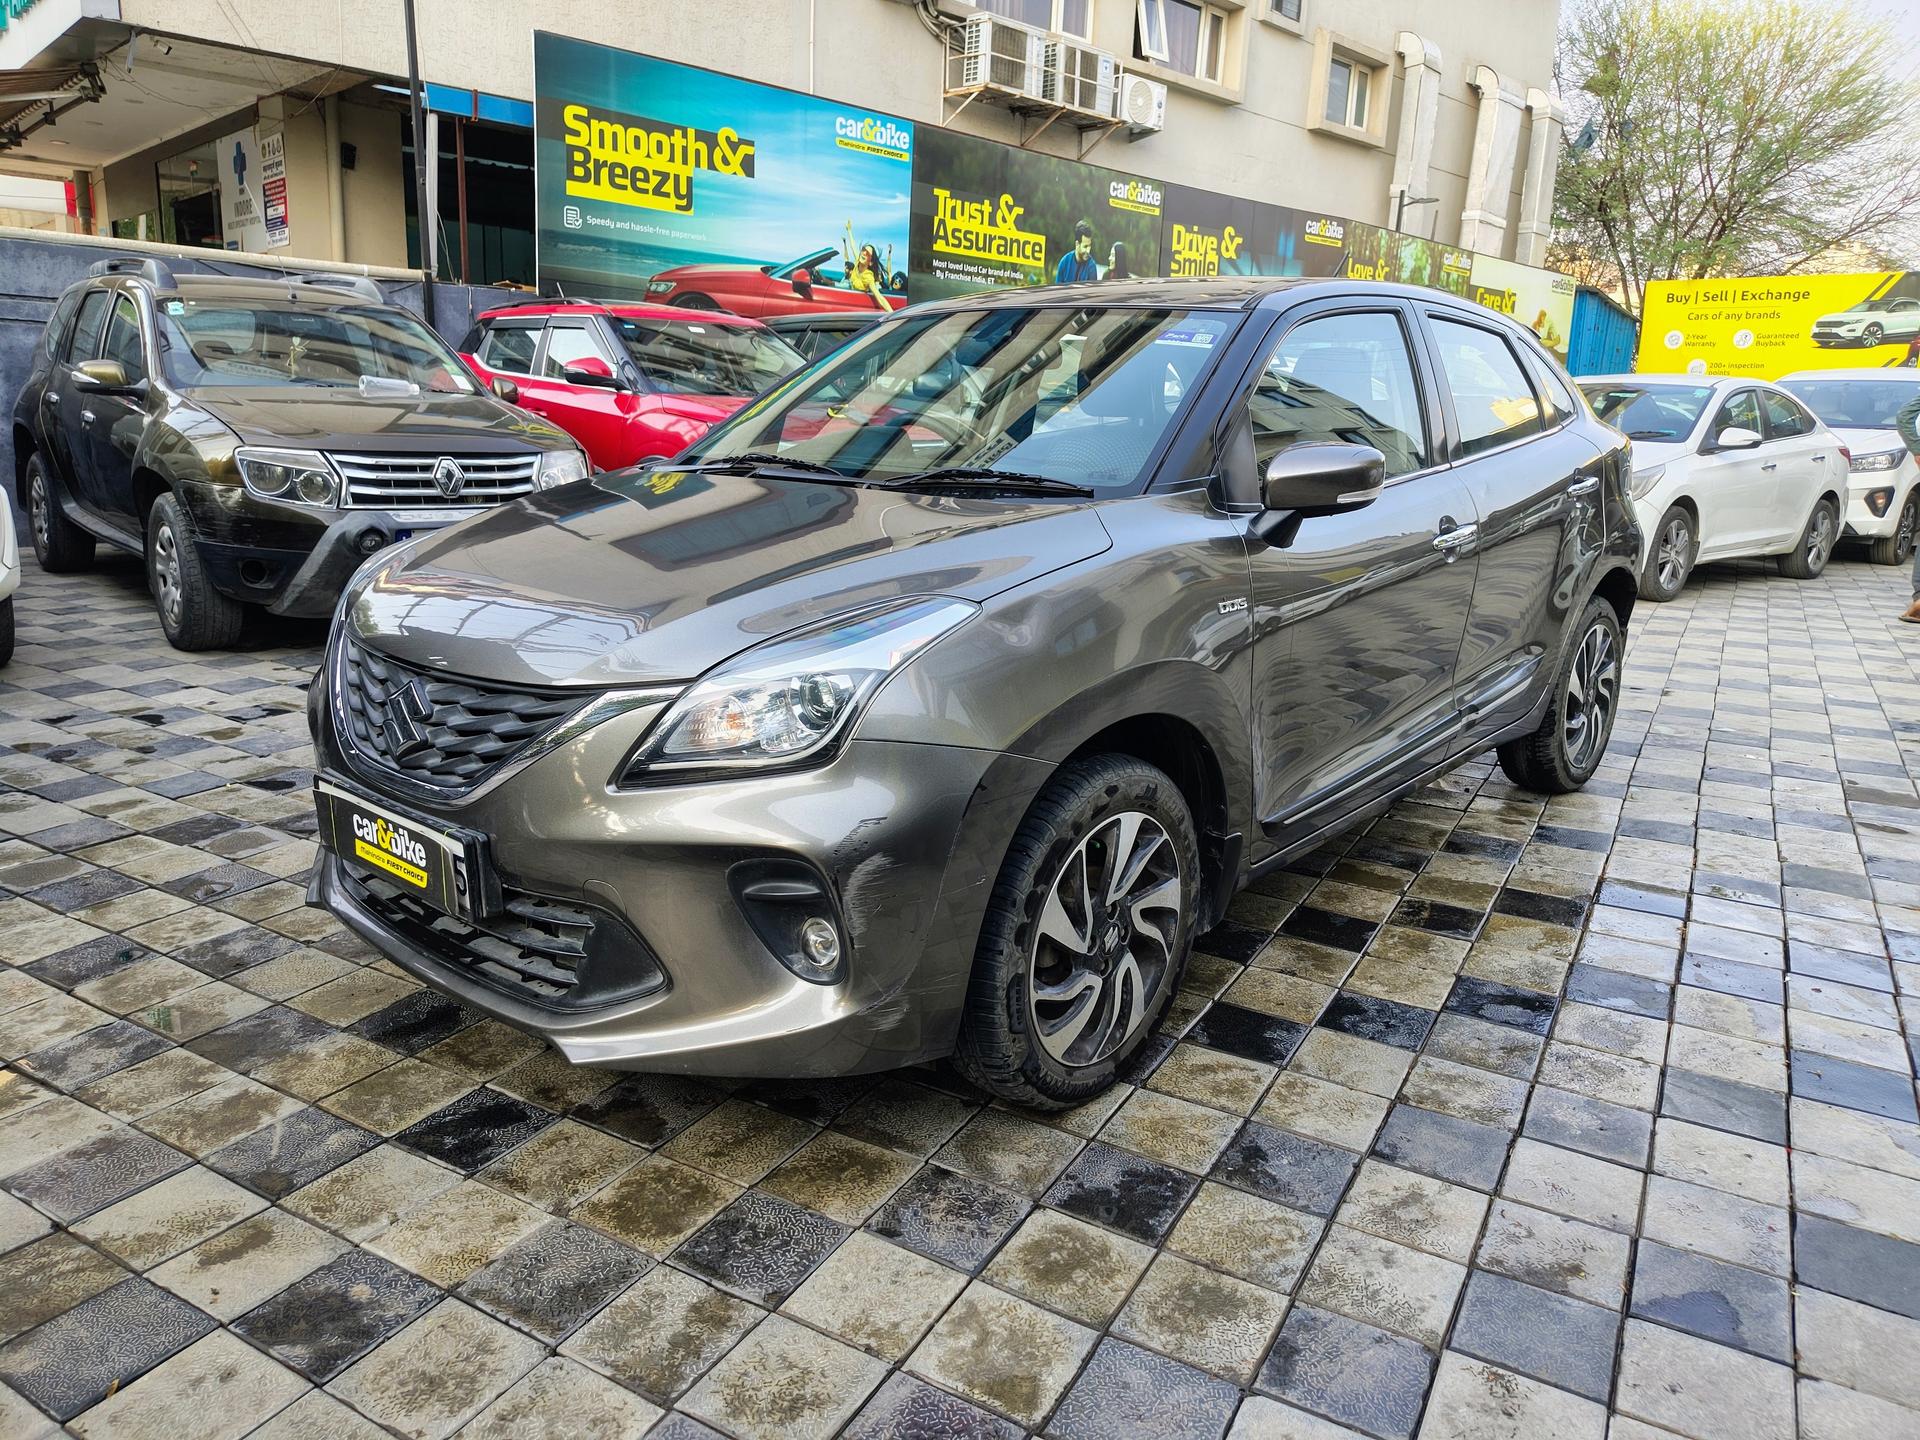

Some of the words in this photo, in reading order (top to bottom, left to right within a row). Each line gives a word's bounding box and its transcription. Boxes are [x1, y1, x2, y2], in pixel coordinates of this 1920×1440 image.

[563, 105, 708, 169] Smooth
[713, 127, 755, 176] &
[836, 117, 910, 149] car&bike
[567, 147, 693, 211] Breezy
[1110, 181, 1161, 205] car&bike
[933, 188, 992, 226] Trust
[996, 193, 1024, 231] &
[586, 215, 615, 228] Speedy
[616, 220, 630, 229] and
[631, 222, 671, 234] hassle-free
[1306, 219, 1344, 239] car&bike
[933, 218, 1043, 261] Assurance
[1171, 224, 1218, 256] Drive
[1220, 226, 1243, 259] &
[932, 258, 947, 268] Most
[948, 261, 963, 271] loved
[964, 263, 977, 272] Used
[978, 266, 987, 274] Car
[988, 267, 1004, 276] brand
[1004, 269, 1010, 277] of
[1011, 270, 1023, 279] India
[936, 269, 944, 279] By
[945, 271, 971, 282] Franchise
[1347, 258, 1373, 280] Love
[1666, 292, 1691, 305] Buy
[1703, 290, 1728, 302] Sell
[1741, 289, 1810, 302] Exchange
[1687, 312, 1709, 321] Cars
[1711, 311, 1722, 320] of
[1724, 312, 1743, 321] any
[1745, 310, 1781, 320] brands
[1755, 340, 1786, 348] Buyback
[1728, 361, 1765, 369] inspection
[353, 814, 426, 867] car&bike
[386, 859, 403, 872] FIRST
[403, 867, 424, 882] CHOICE
